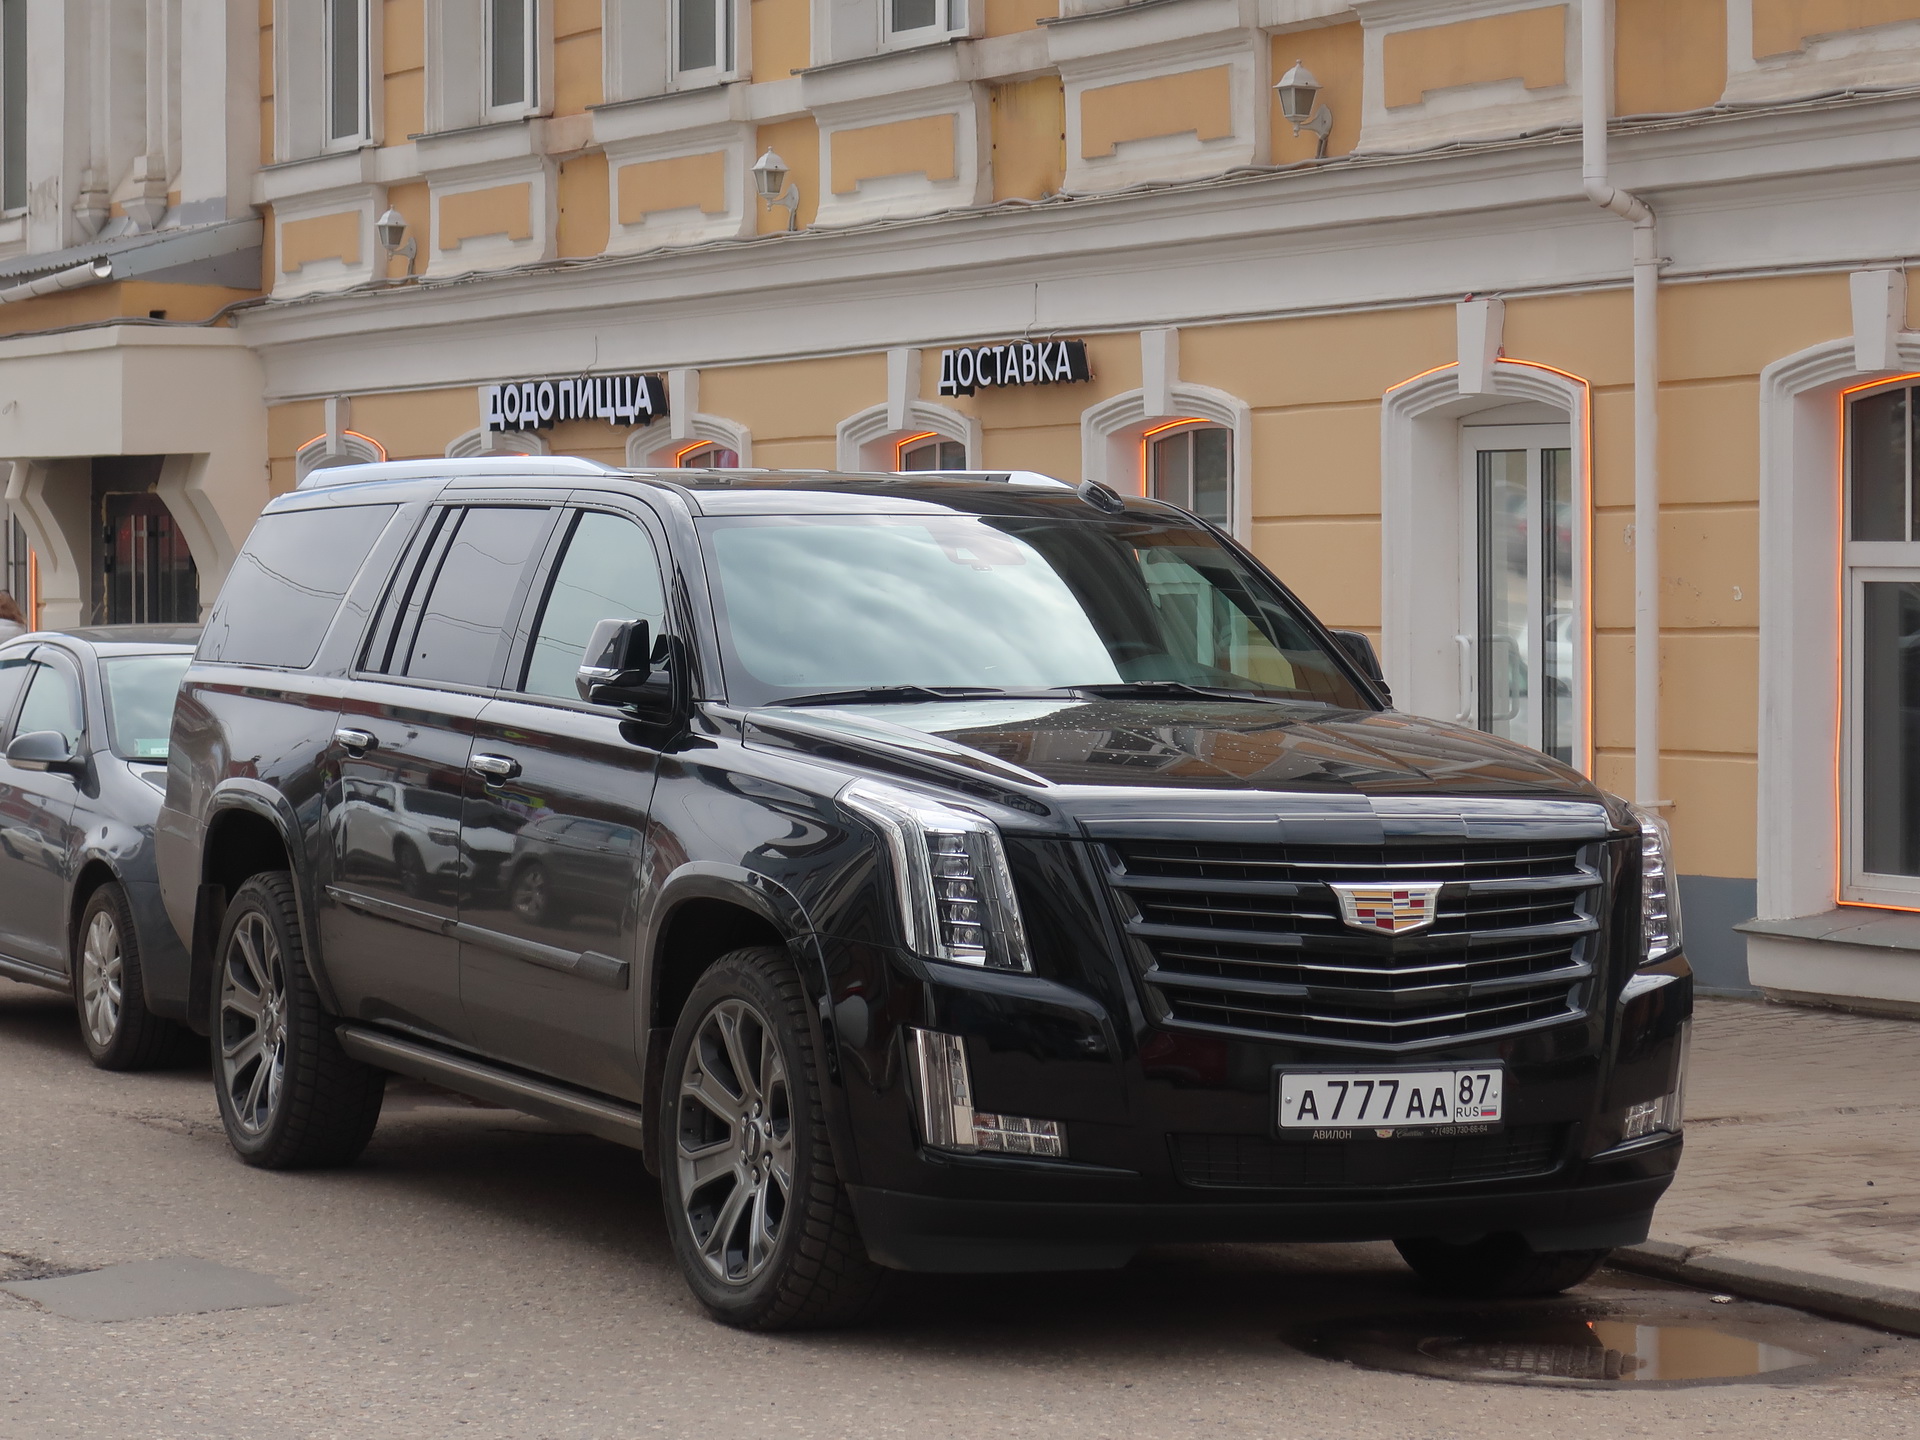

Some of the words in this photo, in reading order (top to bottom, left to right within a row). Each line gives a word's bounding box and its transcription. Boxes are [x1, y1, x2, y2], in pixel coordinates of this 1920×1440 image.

[937, 340, 1072, 396] ДОСТАВКА
[487, 381, 554, 431] ДОДО
[558, 375, 653, 426] ПИЦЦА
[1458, 1074, 1491, 1105] 87
[1456, 1106, 1480, 1118] RUS
[1312, 1129, 1352, 1140] АВИЛОН
